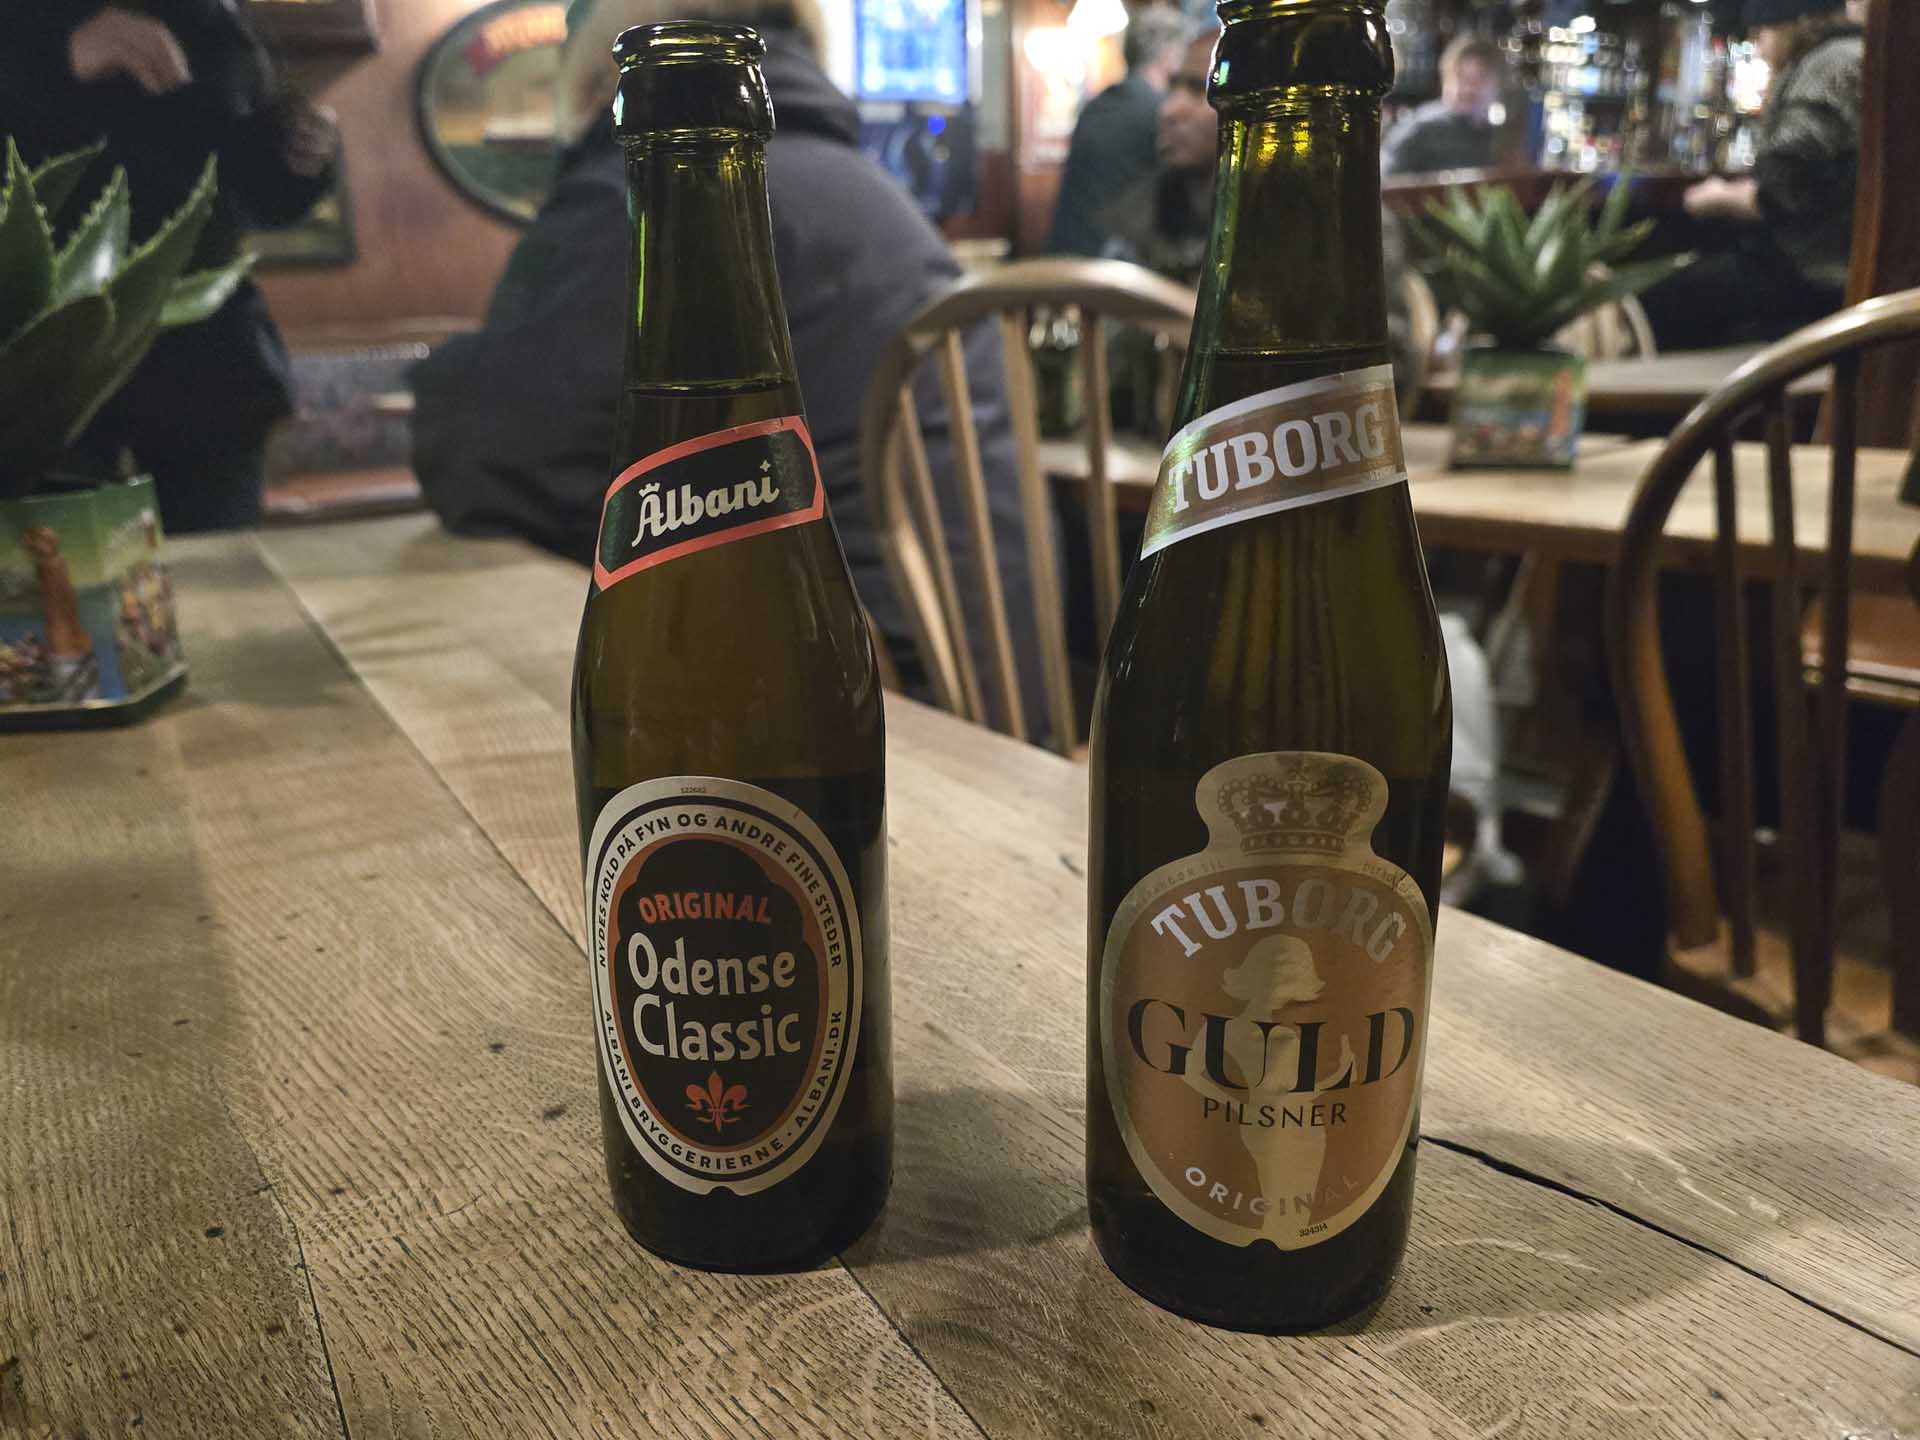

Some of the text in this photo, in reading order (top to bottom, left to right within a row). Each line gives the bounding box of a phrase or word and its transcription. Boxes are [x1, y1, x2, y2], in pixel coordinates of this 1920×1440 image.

[1168, 403, 1385, 513] TUBORG
[631, 460, 780, 547] Albani
[598, 813, 842, 968] NYDES KOLD PÅ FYN OG ANDRE FINE STEDER
[639, 892, 772, 925] ORIGINAL
[1151, 878, 1406, 963] TUBORG
[628, 932, 796, 995] Odense
[633, 993, 801, 1061] Classic
[1127, 998, 1415, 1093] GULD
[604, 1010, 842, 1170] ALBANI BRYGGERIERNE ALBANI.DK
[1203, 1096, 1347, 1129] PILSNER
[1185, 1166, 1361, 1216] ORIGINAL
